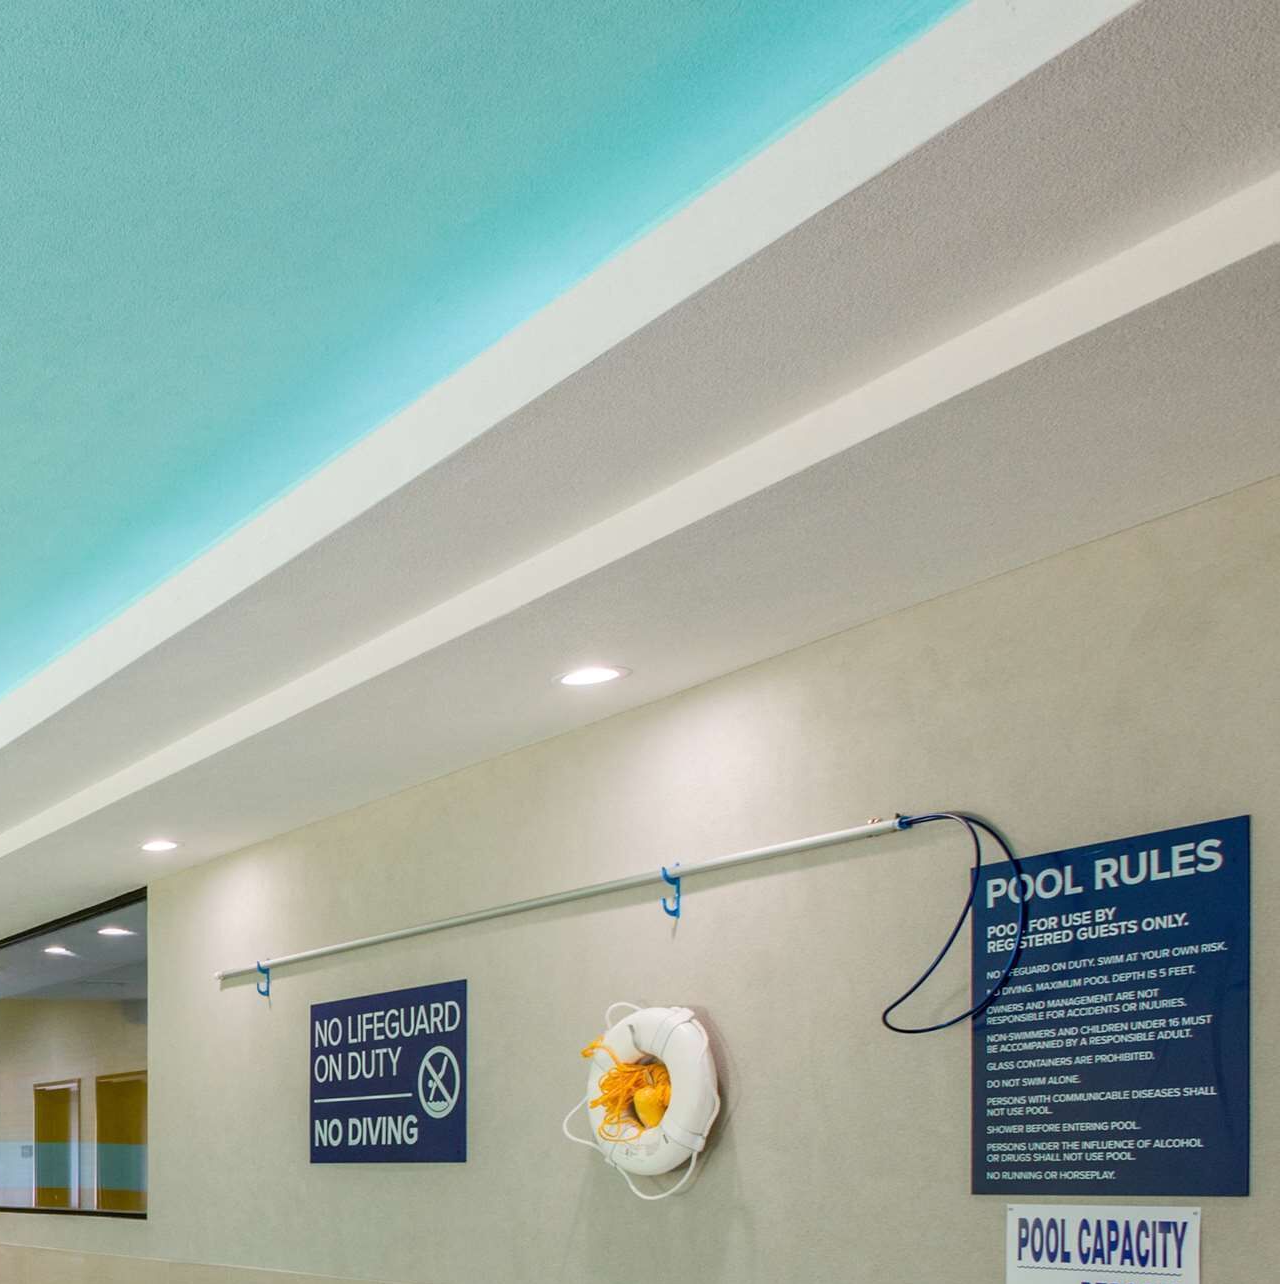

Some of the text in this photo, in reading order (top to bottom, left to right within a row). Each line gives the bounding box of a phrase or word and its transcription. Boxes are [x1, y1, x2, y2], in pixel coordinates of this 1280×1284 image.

[986, 837, 1221, 908] POOL RULES
[987, 907, 1115, 938] POO FOR USE BY
[987, 912, 1188, 953] REGSTERED GUESTS ONLY.
[986, 970, 999, 979] NO
[1052, 962, 1065, 971] ON
[1097, 955, 1122, 965] SWIM
[1125, 953, 1137, 962] AT
[1140, 949, 1169, 960] YOUR
[1172, 945, 1198, 956] OWN
[1201, 941, 1228, 953] RISK.
[1035, 978, 1081, 991] MAXIMUM
[1083, 975, 1109, 986] POOL
[1112, 971, 1145, 983] DEPTH
[1147, 970, 1156, 979] IS
[1159, 968, 1166, 977] 5
[1168, 965, 1195, 976] FEET.
[986, 988, 1158, 1014] OWNERS AND MANAGEMENT ARE NOT
[986, 998, 1186, 1025] RESPONSIBLE FOR ACCIDENTS OR INJURIES.
[315, 1001, 460, 1048] NO LIFEGUARD
[986, 1015, 1212, 1042] NON-SWIMMERS AND CHILDREN UNDER 16 MUST
[986, 1029, 1192, 1053] BE ACCOMPANIED BY A RESPONSIBLE ADULT.
[314, 1047, 401, 1083] ON DUTY
[986, 1051, 1154, 1070] GLASS CONTAINERS ARE PROHIBITED.
[986, 1079, 999, 1088] DO
[1002, 1078, 1019, 1087] NOT
[1022, 1077, 1045, 1086] SWIM
[986, 1086, 1216, 1105] PERSONS WITH COMMUNICABLE DISEASES SHALL
[986, 1108, 1004, 1116] NOT
[1006, 1107, 1023, 1115] USE
[315, 1115, 418, 1146] NO DIVING
[986, 1125, 1023, 1133] SHOWER
[1026, 1124, 1060, 1132] BEFORE
[1062, 1122, 1108, 1131] ENTERING
[986, 1138, 1203, 1151] PERSONS UNDER THE INFLUENCE OF ALCOHOL
[986, 1154, 999, 1162] OR
[1001, 1153, 1030, 1161] DRUGS
[1033, 1153, 1060, 1161] SHALL
[1063, 1152, 1082, 1161] NOT
[1085, 1152, 1103, 1160] USE
[986, 1171, 1115, 1179] NO RUNNING OR HORSEPLAY.
[1018, 1217, 1187, 1268] POOL CAPACITY
